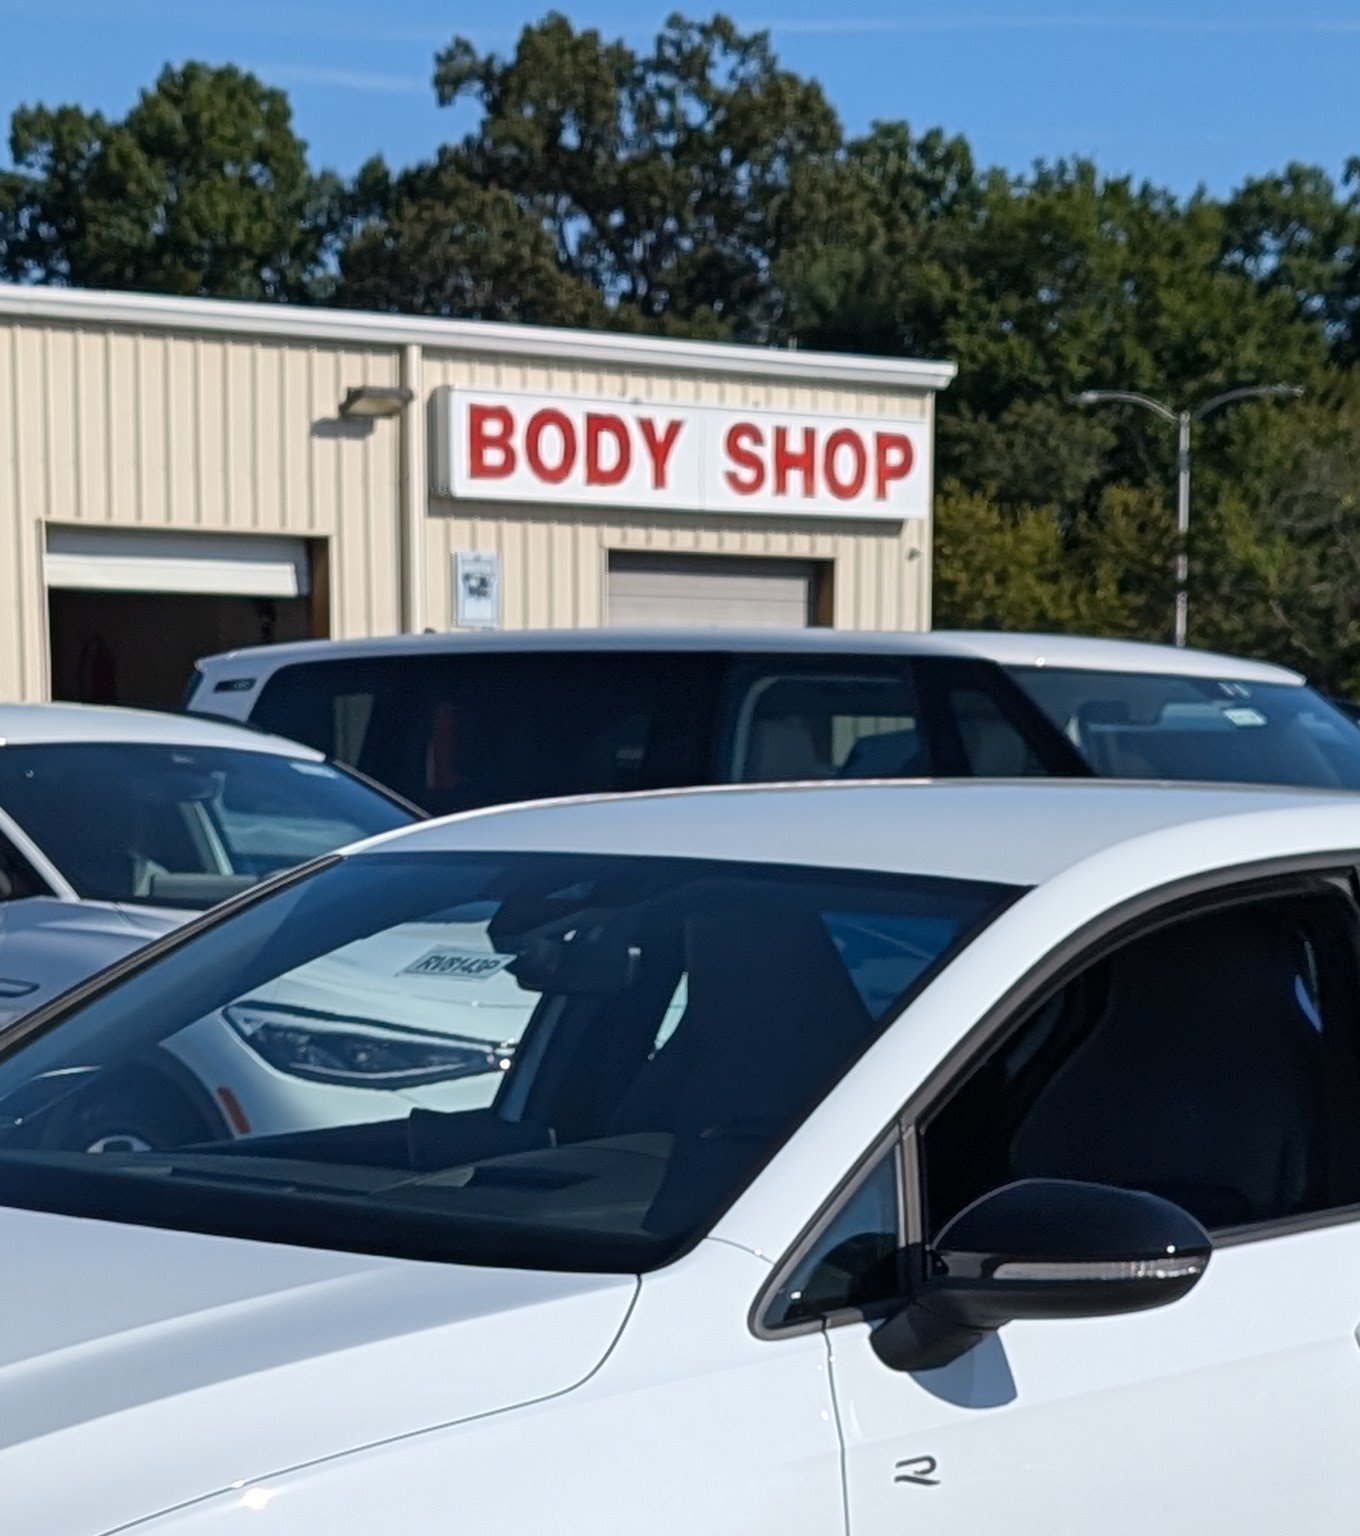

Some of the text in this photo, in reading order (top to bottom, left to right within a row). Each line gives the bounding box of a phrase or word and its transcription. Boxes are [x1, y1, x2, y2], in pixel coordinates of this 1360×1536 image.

[469, 404, 914, 501] BODY SHOP
[894, 1455, 941, 1486] R
